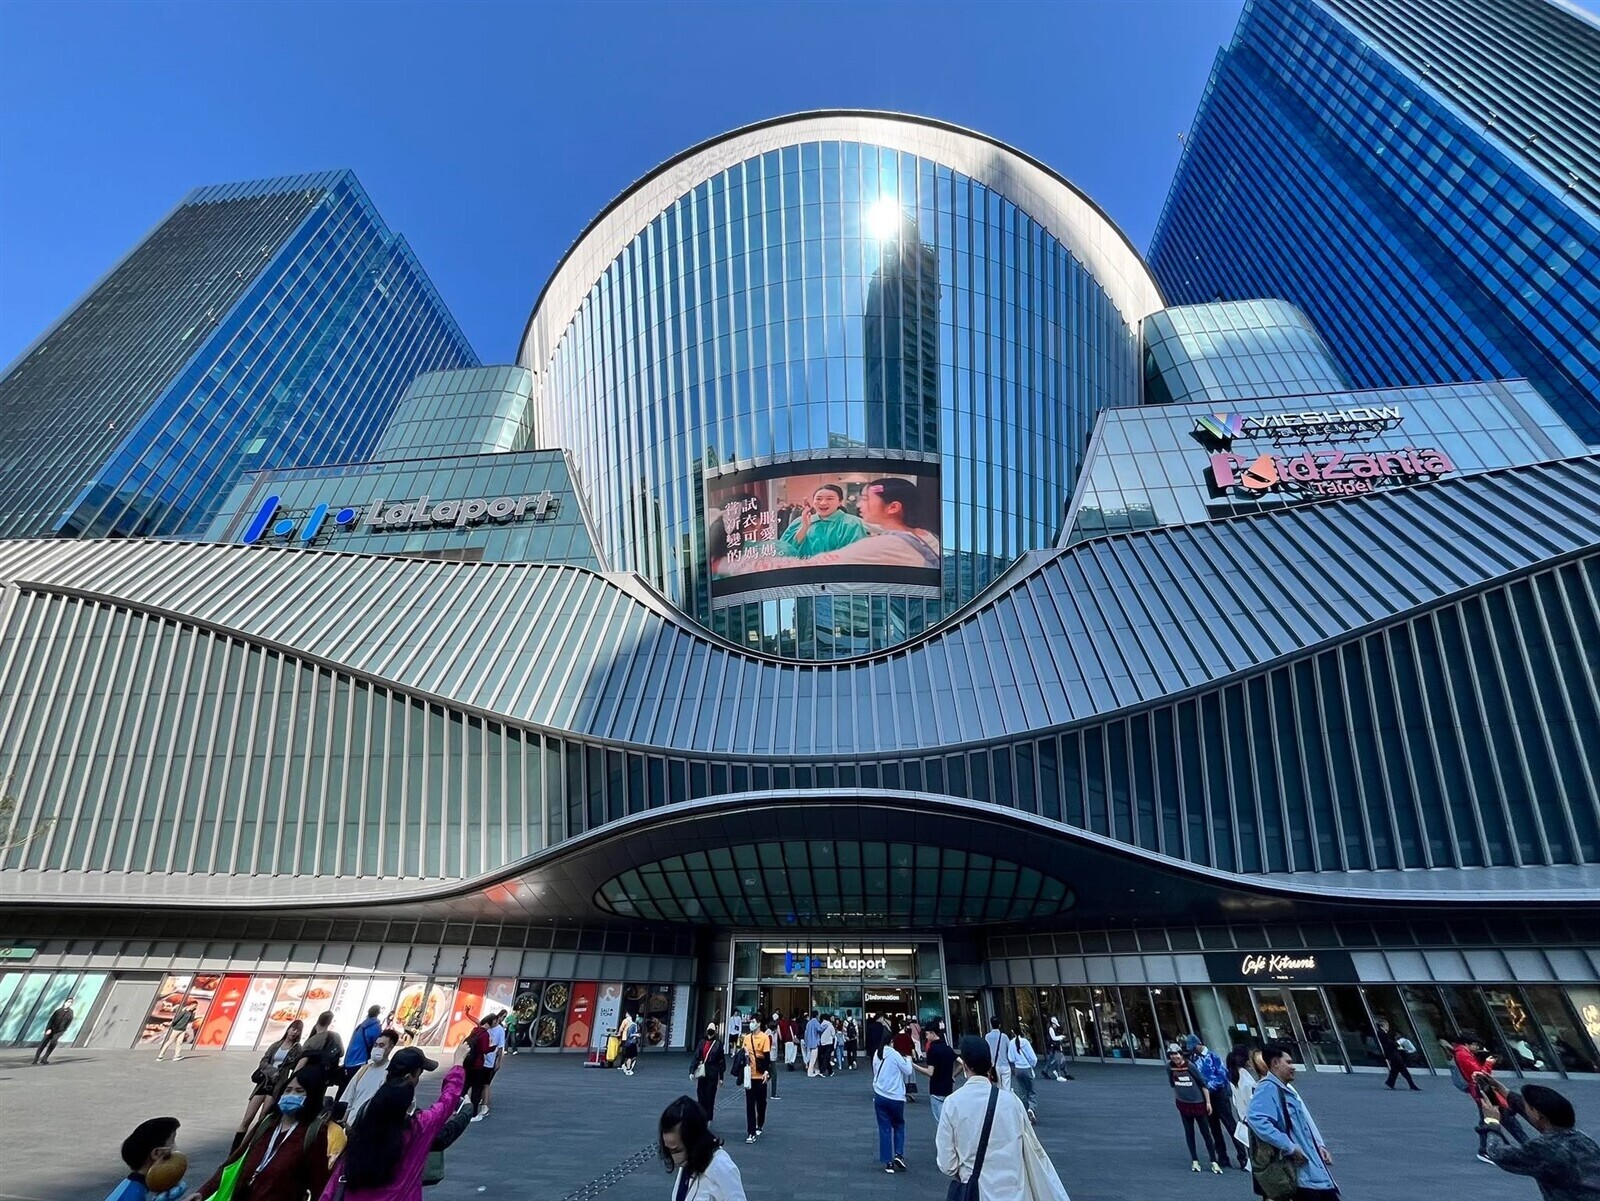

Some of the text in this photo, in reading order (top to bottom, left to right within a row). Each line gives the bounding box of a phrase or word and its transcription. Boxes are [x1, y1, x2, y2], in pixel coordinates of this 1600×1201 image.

[1248, 405, 1402, 428] VIESHOW
[1279, 423, 1383, 437] CINEMAS
[1313, 480, 1373, 496] Taipei
[364, 490, 554, 527] LaLaport
[724, 497, 758, 516] 嘗試
[726, 526, 776, 548] 變可愛
[826, 956, 887, 972] LaLaport
